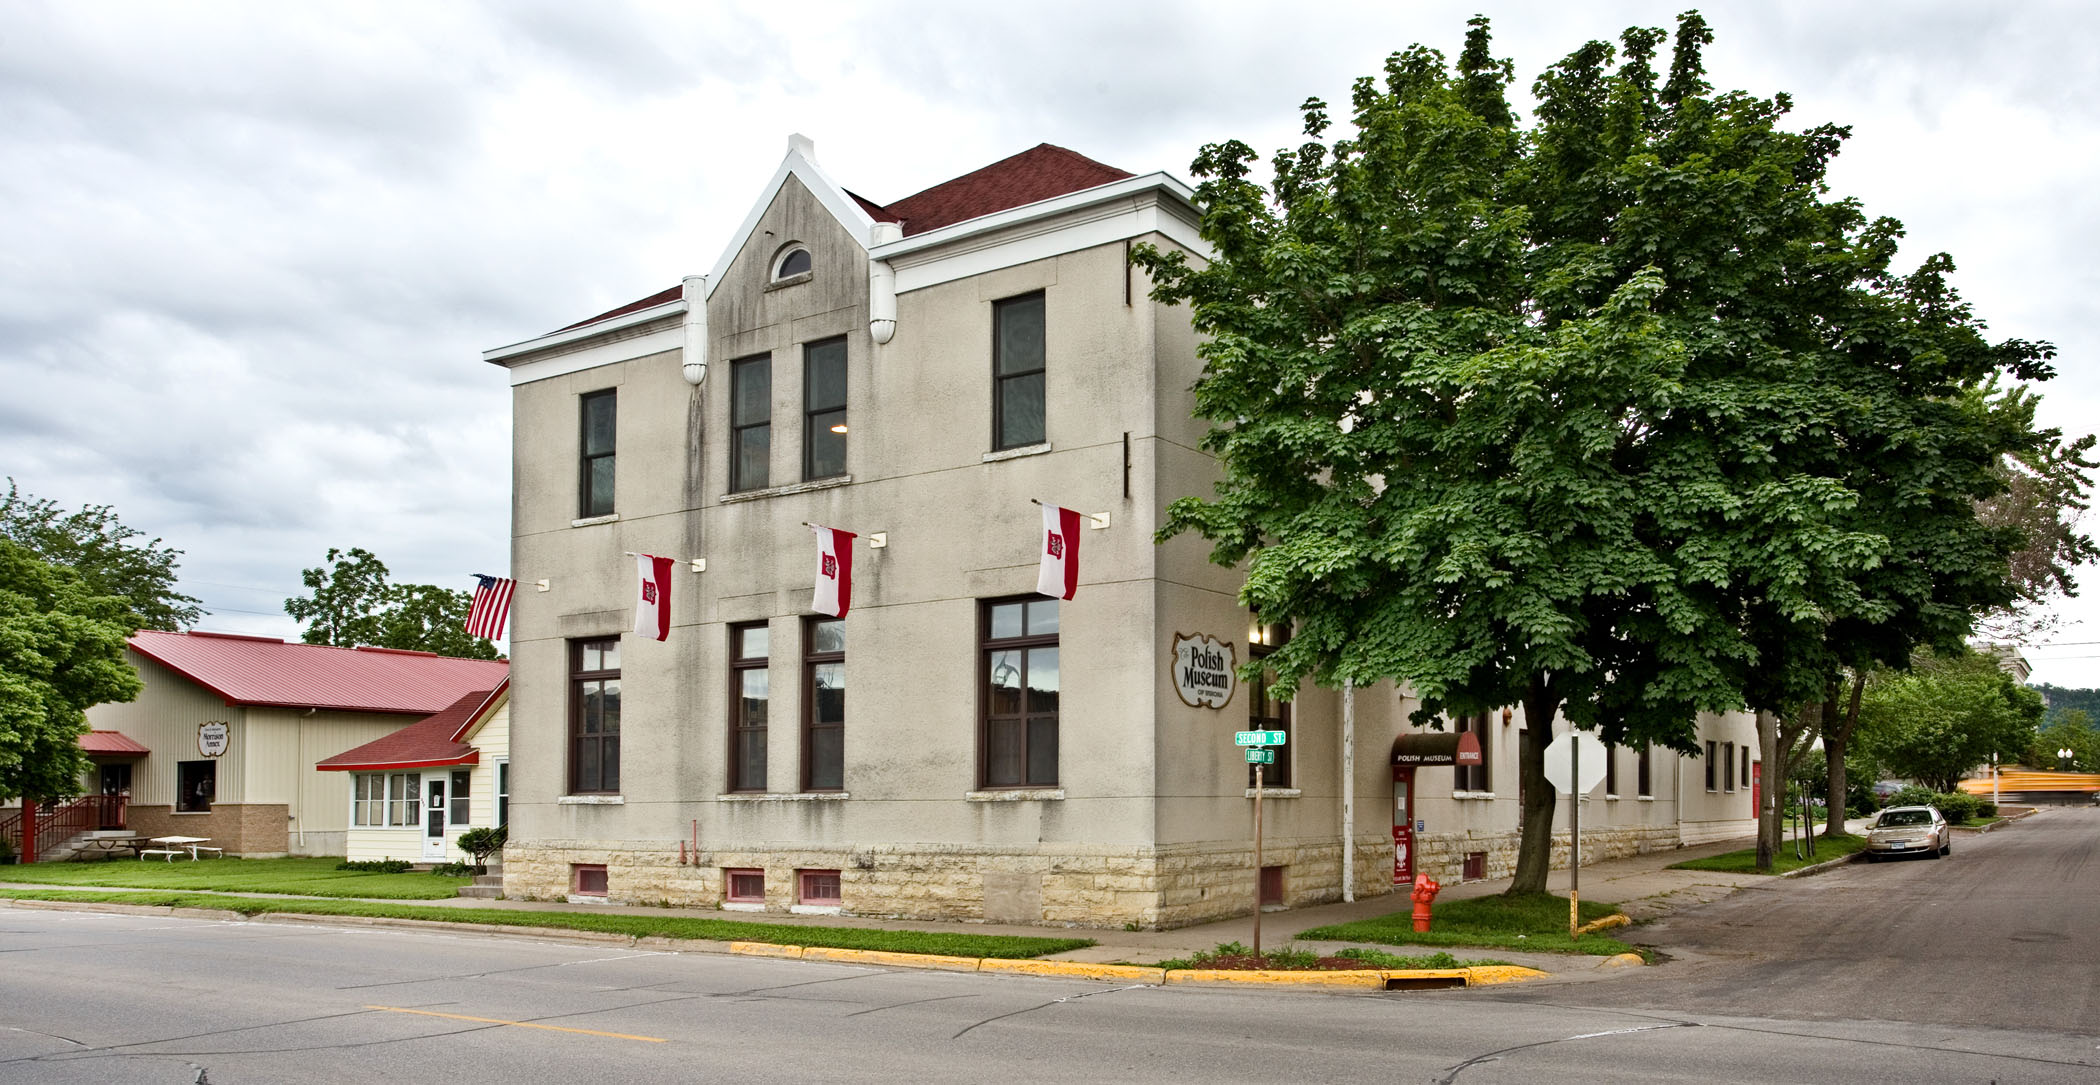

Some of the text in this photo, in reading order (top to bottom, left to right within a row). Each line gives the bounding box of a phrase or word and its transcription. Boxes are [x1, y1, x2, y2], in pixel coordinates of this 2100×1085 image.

[1191, 645, 1224, 671] Polish
[1183, 666, 1228, 689] Museum
[1238, 732, 1283, 744] SECOND ST
[1247, 750, 1273, 762] LIBERTY ST
[1459, 752, 1479, 760] ENTRANCE
